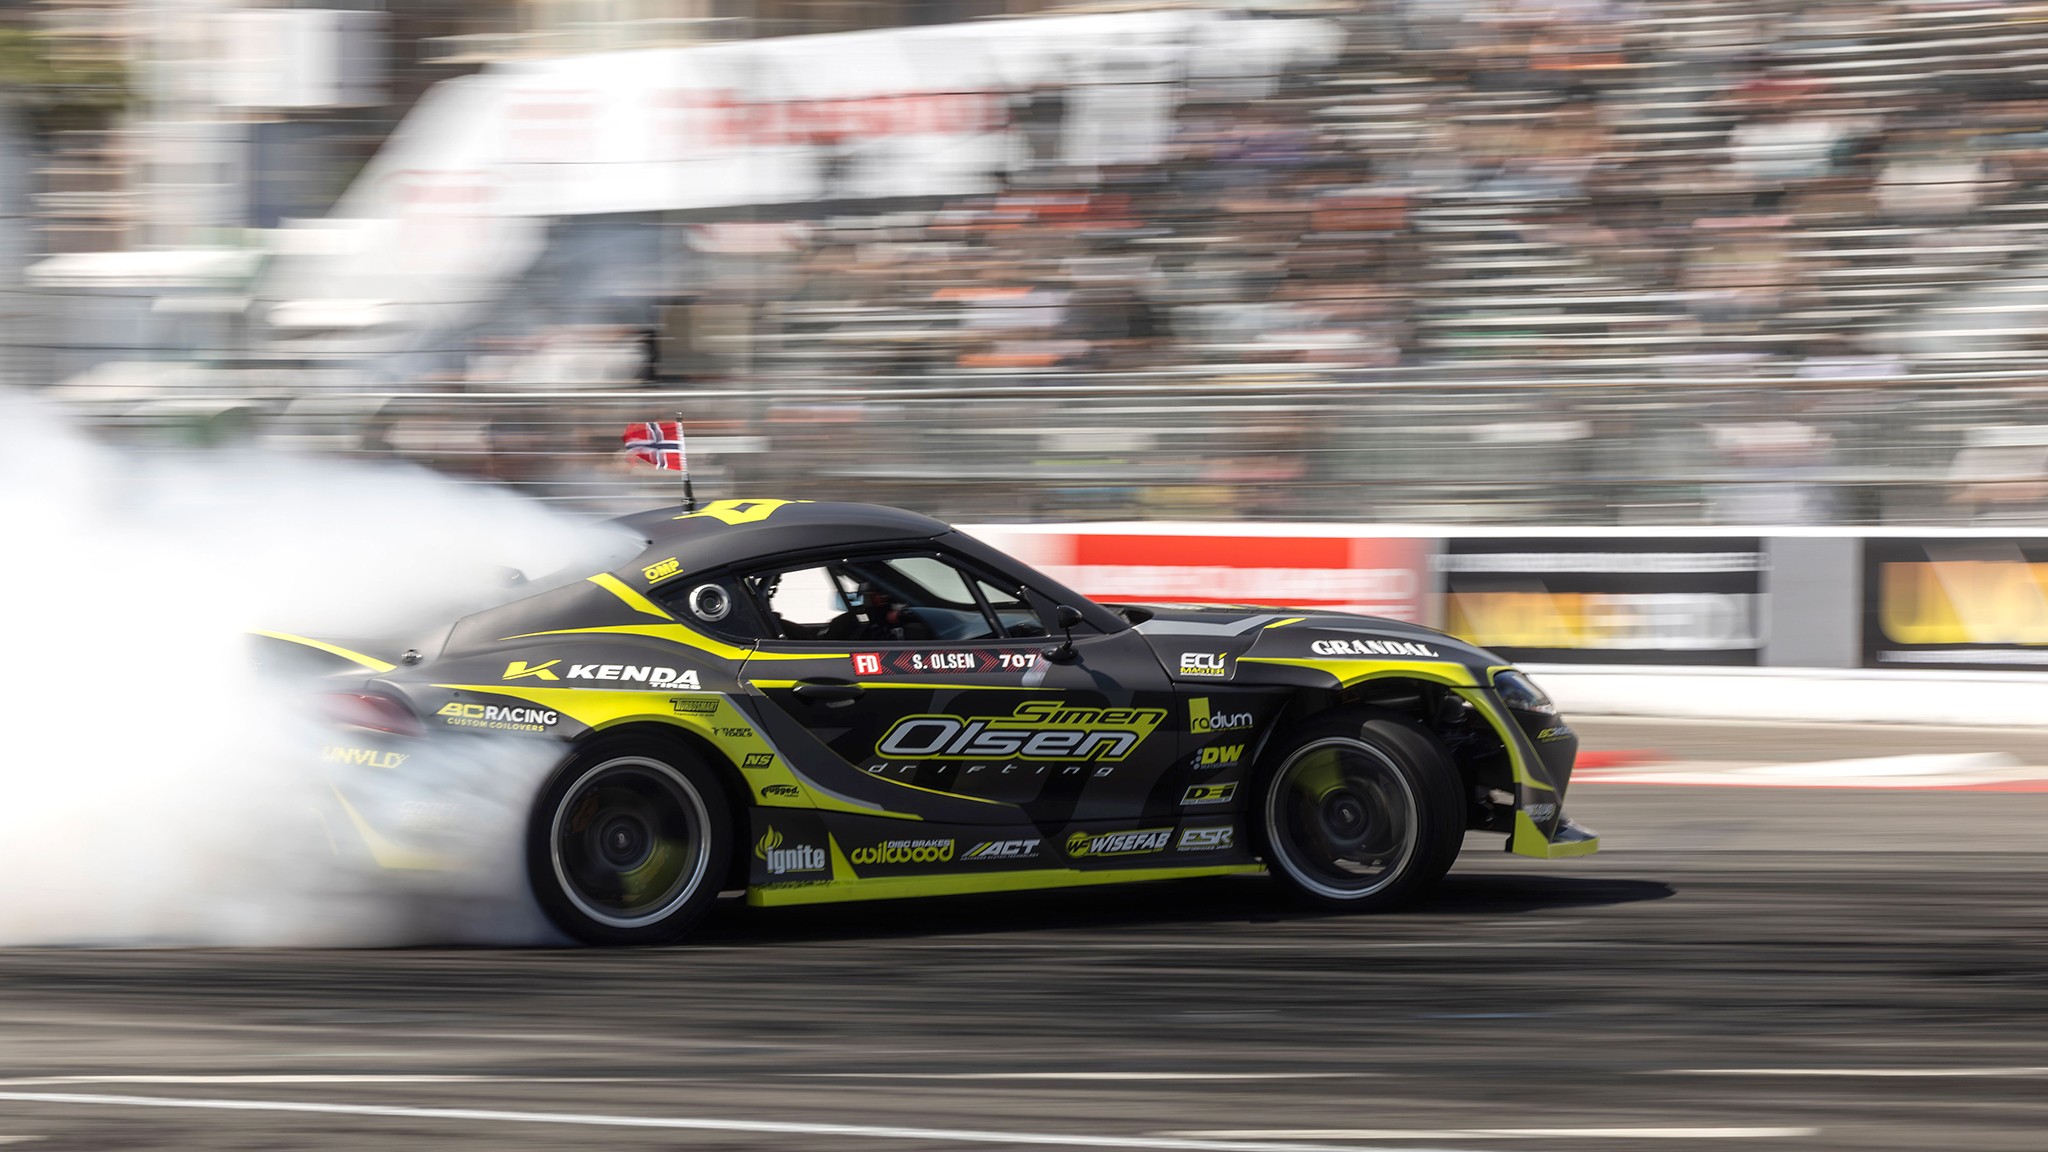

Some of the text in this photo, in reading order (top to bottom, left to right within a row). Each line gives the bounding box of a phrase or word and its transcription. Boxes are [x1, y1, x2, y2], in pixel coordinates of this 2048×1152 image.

[645, 561, 680, 581] OMP
[1311, 640, 1439, 658] GRANDAL
[856, 655, 879, 673] FD
[912, 653, 975, 669] S. OLSEN
[999, 654, 1036, 668] 707
[1180, 652, 1227, 668] ECU
[566, 664, 701, 685] KENDA
[1180, 667, 1225, 675] MASTER
[649, 682, 701, 690] TIRES
[485, 705, 558, 725] RACING
[1003, 701, 1165, 725] Simen
[1192, 711, 1253, 730] radium
[447, 717, 544, 732] CUSTOM COILOVERS
[880, 719, 1139, 756] Olsen
[745, 754, 773, 766] NS
[1201, 744, 1244, 765] DW
[868, 763, 1114, 778] drifting
[888, 839, 950, 849] DISC BRAKES
[1090, 832, 1171, 852] WISEFAB
[1179, 827, 1234, 847] ESR
[851, 838, 954, 864] wilwood
[978, 839, 1040, 856] ACT
[767, 844, 825, 874] ignite
